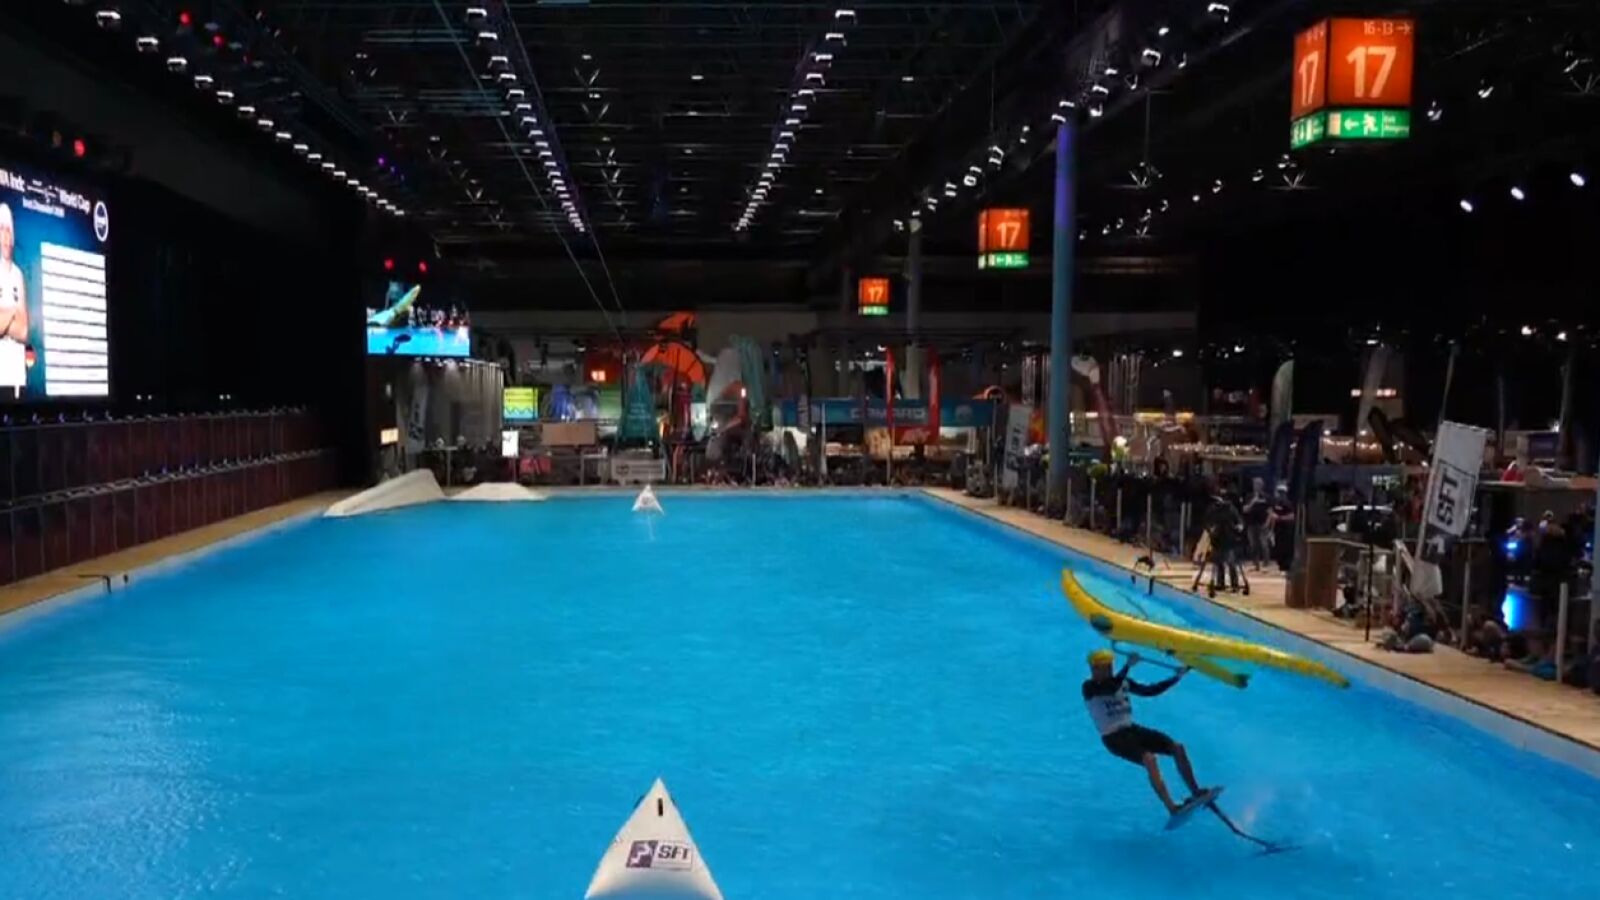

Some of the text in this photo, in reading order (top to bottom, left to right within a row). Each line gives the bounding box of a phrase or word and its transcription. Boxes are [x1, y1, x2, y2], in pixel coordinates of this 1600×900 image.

[1299, 51, 1319, 107] 17
[1346, 46, 1397, 98] 17
[997, 222, 1021, 248] 17
[868, 286, 884, 303] 17
[1436, 467, 1458, 526] SFT
[658, 844, 689, 860] SFT
